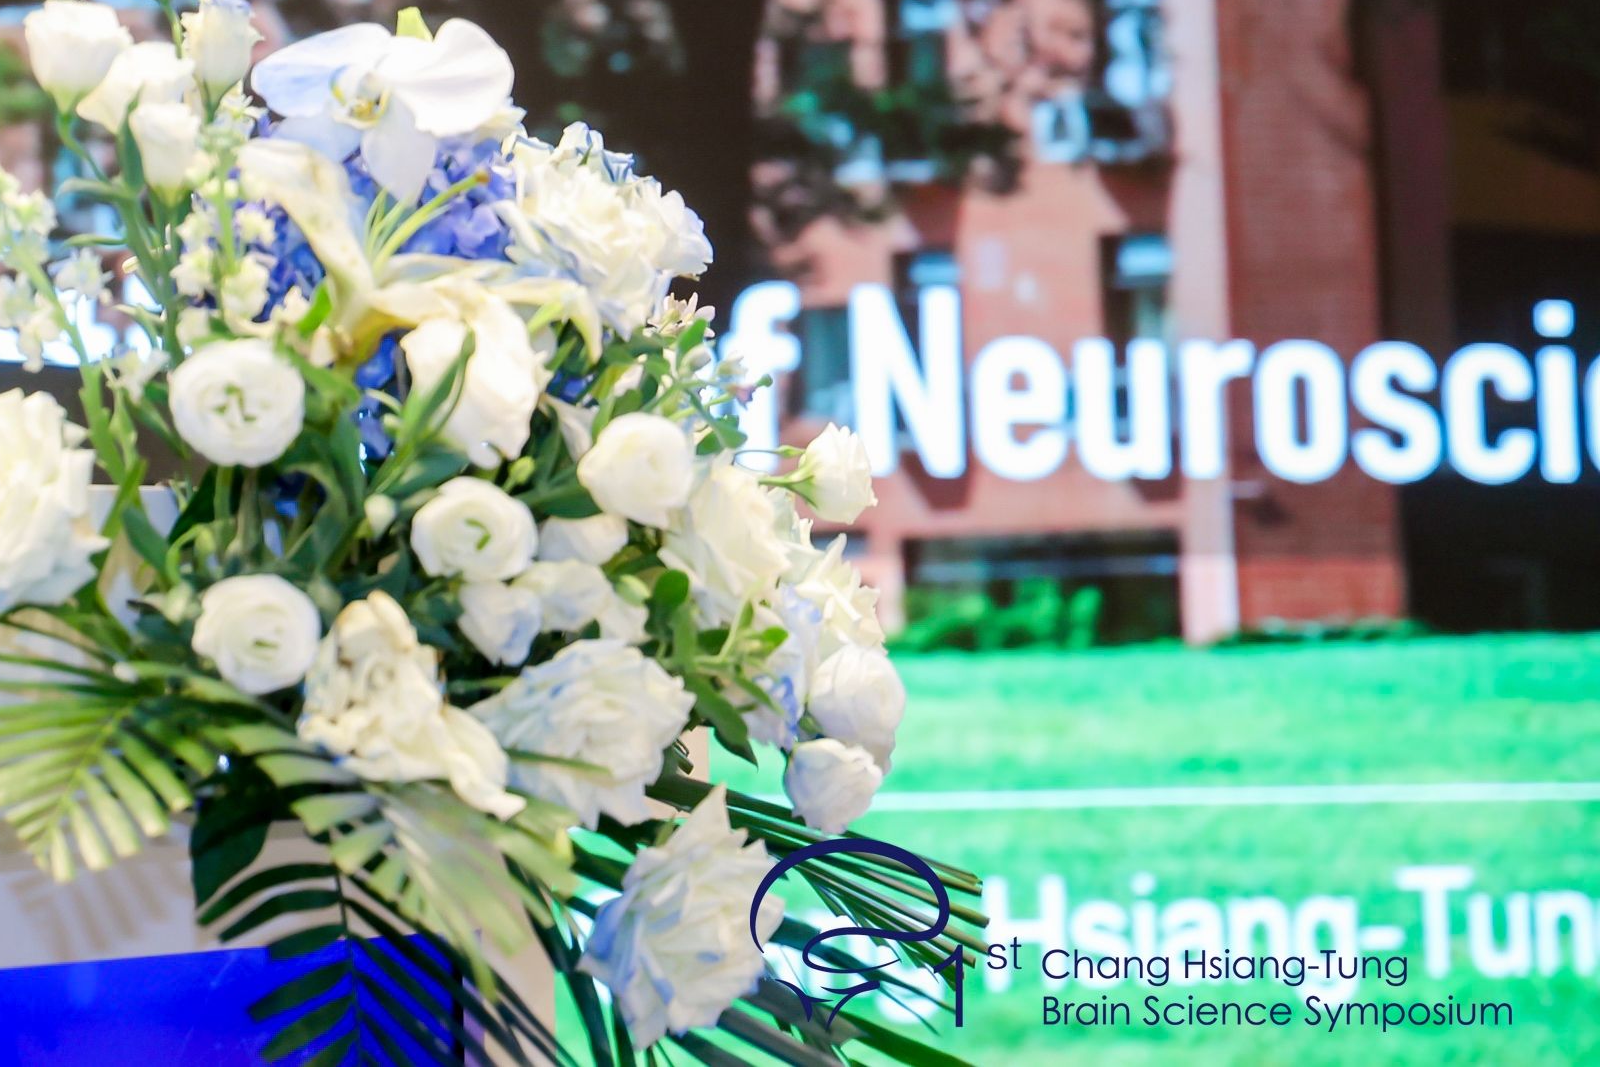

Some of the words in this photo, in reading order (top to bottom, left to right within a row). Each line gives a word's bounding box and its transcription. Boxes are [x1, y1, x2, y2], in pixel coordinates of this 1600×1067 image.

[688, 280, 801, 474] f
[848, 282, 1600, 485] Neurosci
[980, 864, 1600, 1007] Hsiang-Tun
